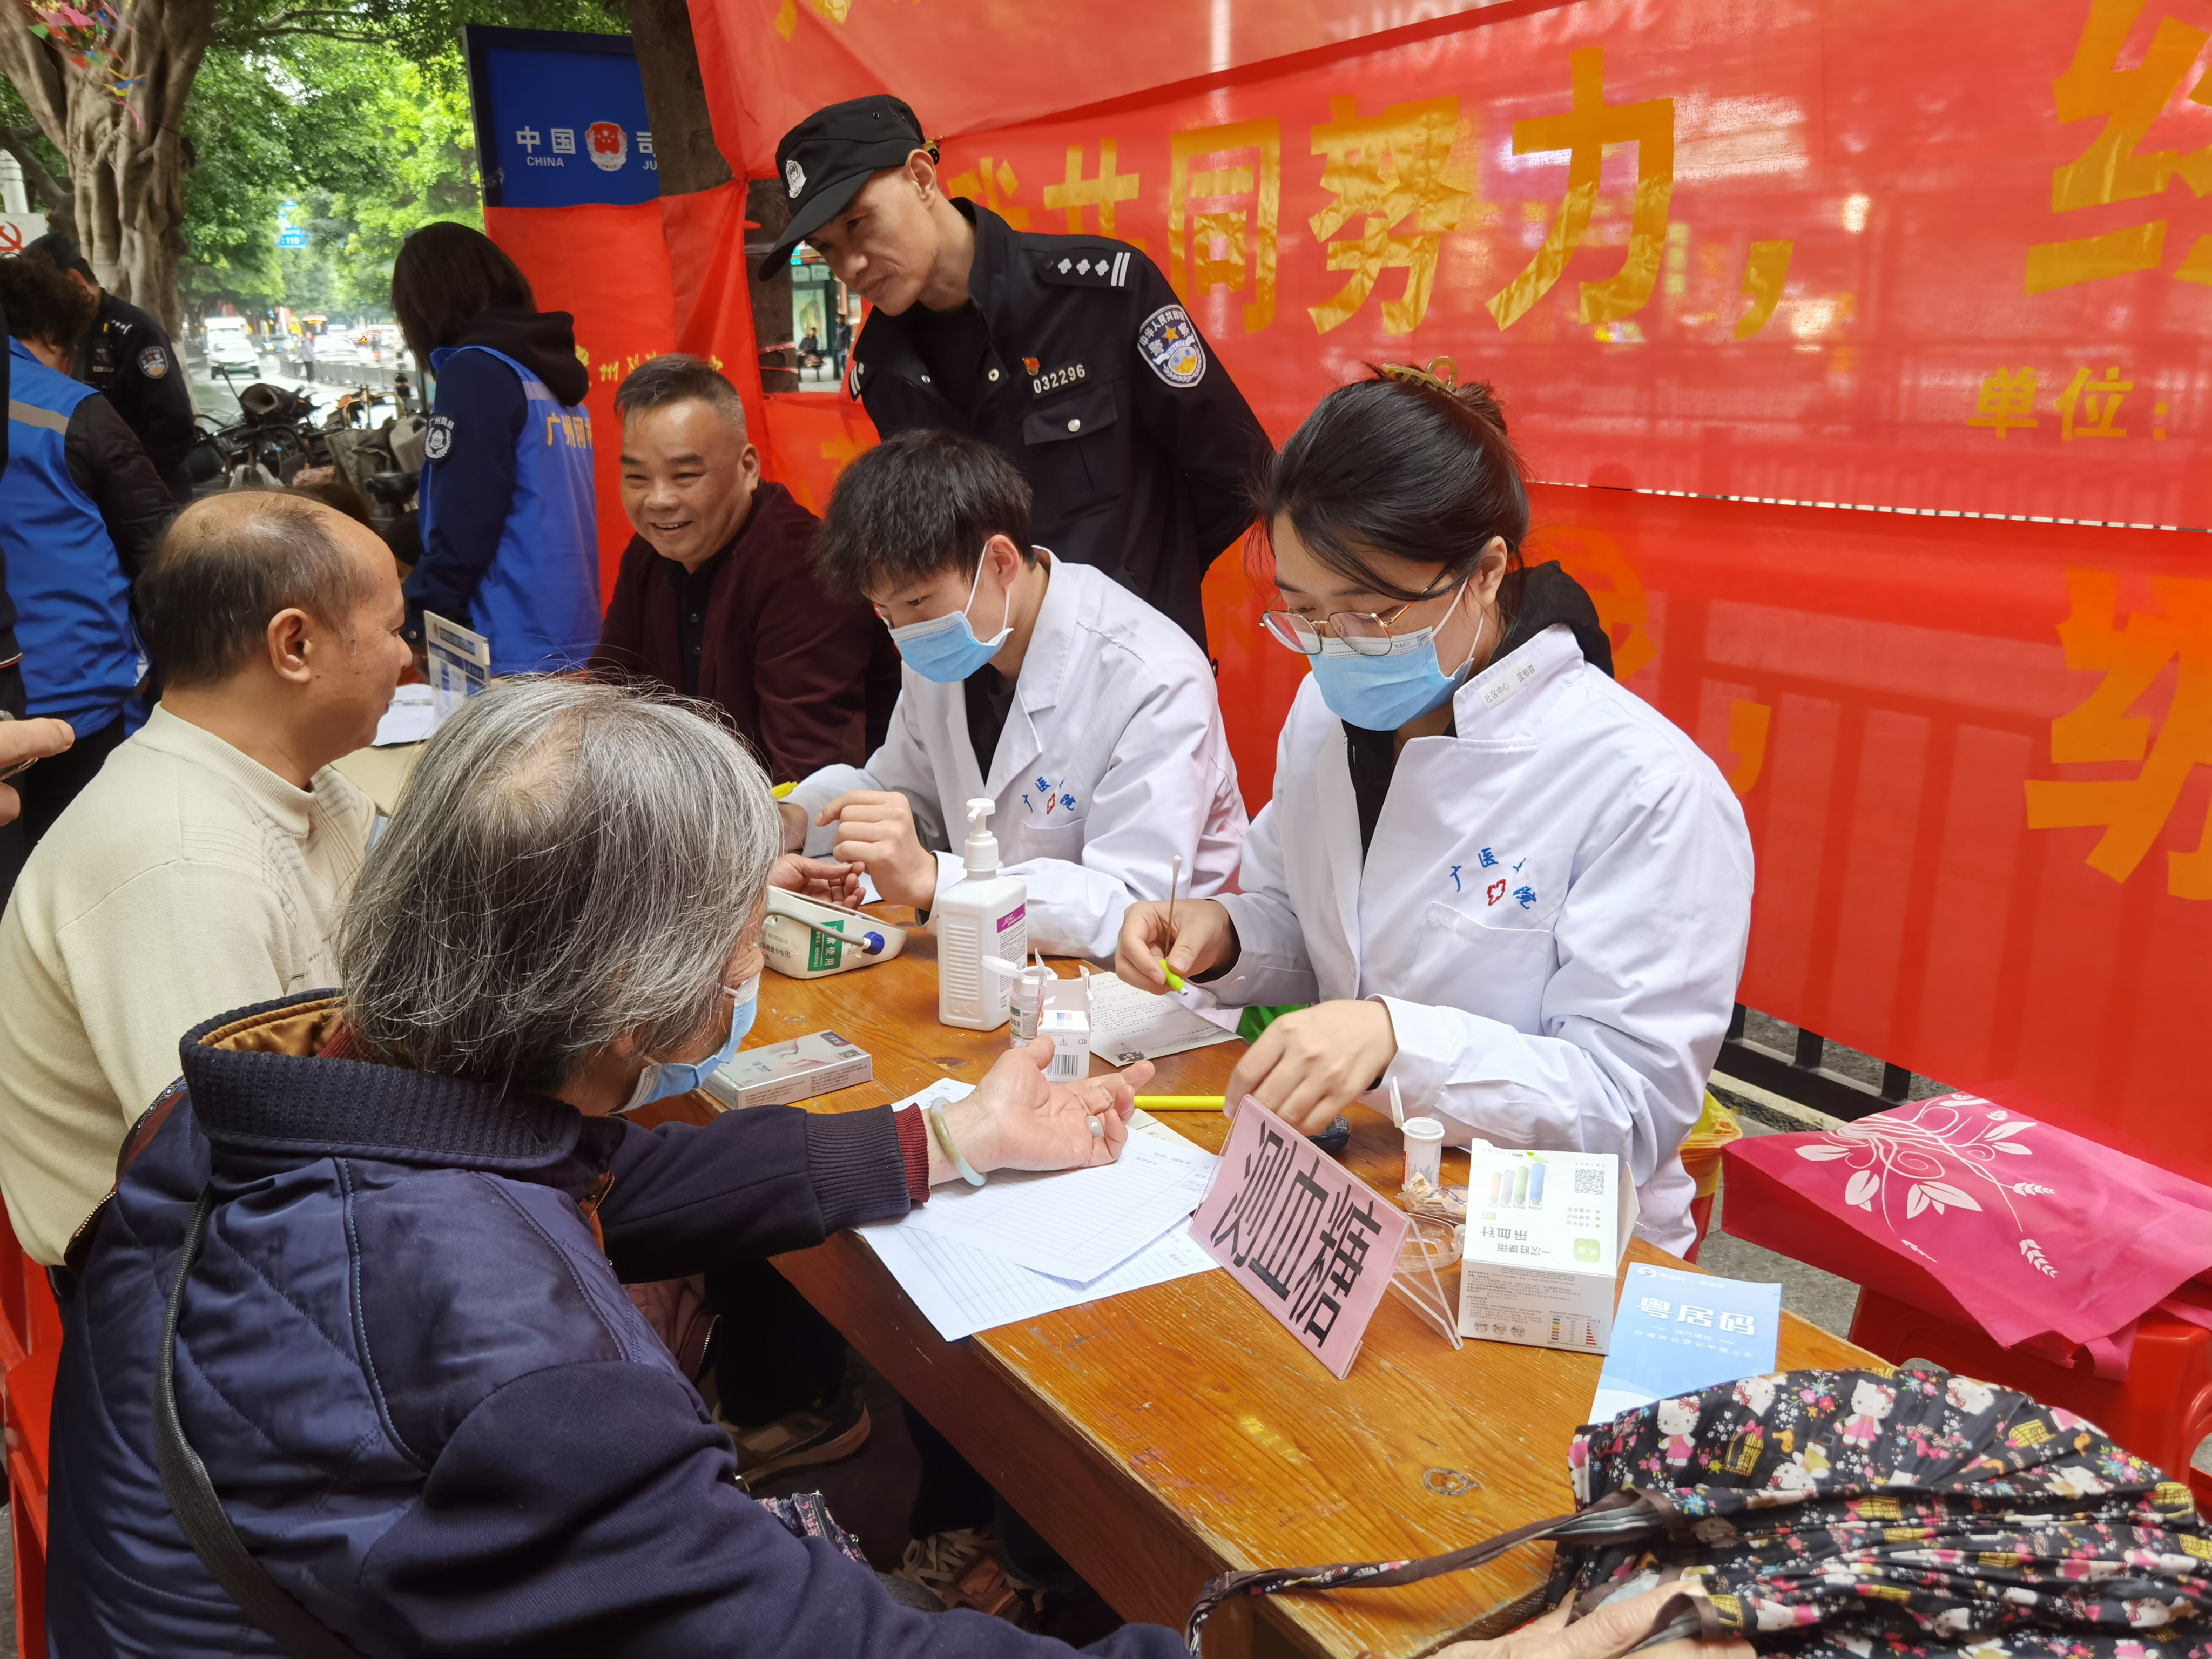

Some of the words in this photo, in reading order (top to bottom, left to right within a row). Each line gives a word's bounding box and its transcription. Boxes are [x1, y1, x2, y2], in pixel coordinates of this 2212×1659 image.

[516, 126, 576, 154] 中国
[527, 157, 564, 167] CHINA
[1139, 309, 1185, 346] 中华人民共和国
[1166, 339, 1188, 357] POLICE
[1033, 363, 1085, 394] 032296
[1483, 682, 1509, 704] 社区中心
[1210, 1120, 1382, 1349] 测血糖
[1480, 1226, 1527, 1242] 采血针
[1497, 1243, 1552, 1256] 一次性使用
[1636, 1297, 1755, 1336] 粤居码
[1634, 1330, 1752, 1359] 办理居住登记申报业务
[1674, 1328, 1712, 1341] 随时随地
